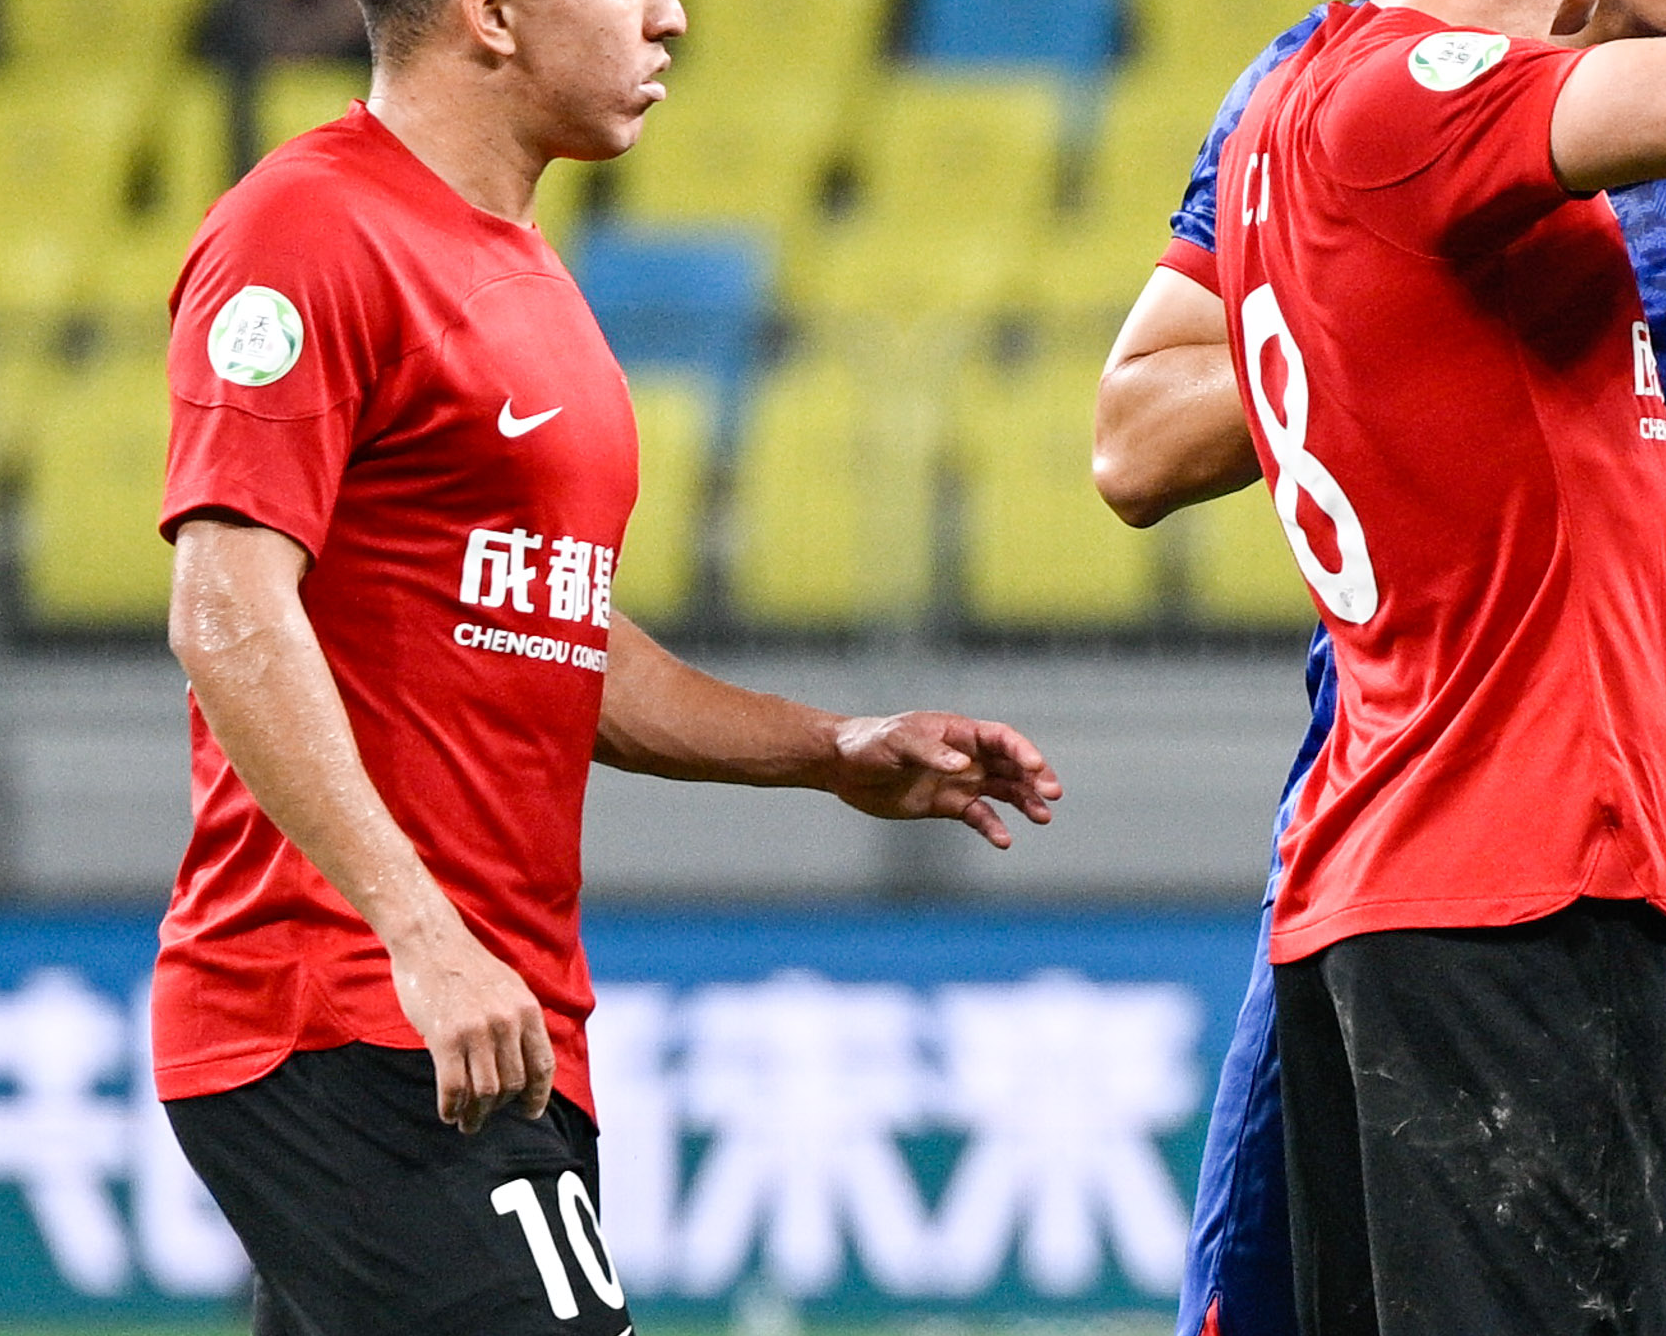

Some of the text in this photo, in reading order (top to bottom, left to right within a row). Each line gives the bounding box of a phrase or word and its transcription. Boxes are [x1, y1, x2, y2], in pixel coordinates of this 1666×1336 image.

[1241, 282, 1378, 625] 8
[453, 622, 571, 664] CHENGDU
[490, 1170, 625, 1320] 10
